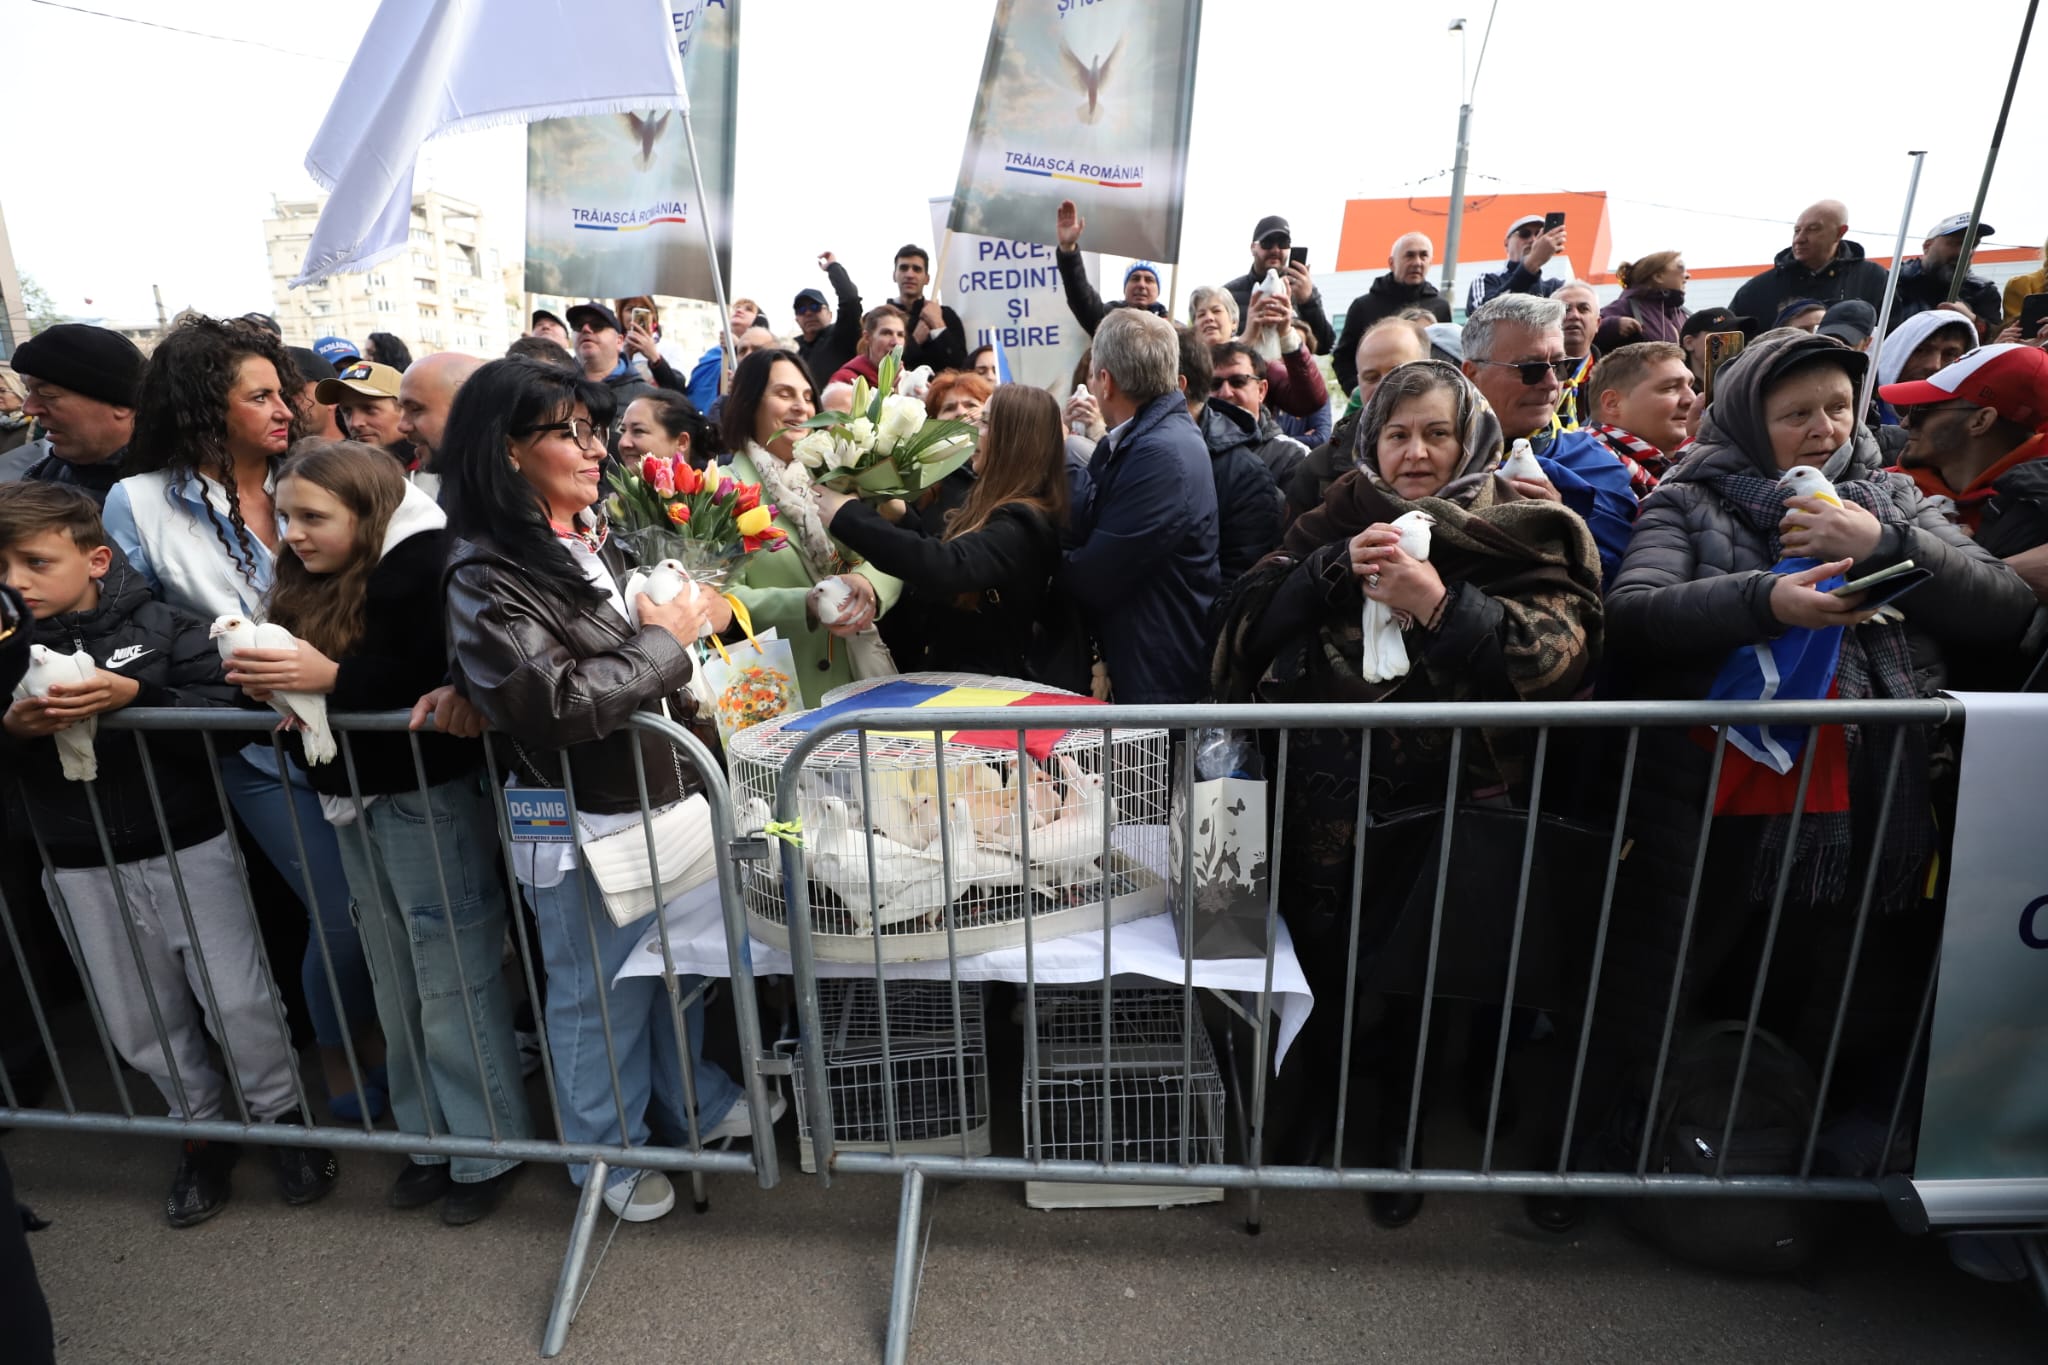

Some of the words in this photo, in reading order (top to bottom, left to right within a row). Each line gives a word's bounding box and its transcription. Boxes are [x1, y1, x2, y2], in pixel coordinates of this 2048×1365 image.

[1005, 151, 1075, 173] TRĂIASCĂ
[1079, 164, 1144, 179] ROMÂNIA!
[979, 240, 1051, 261] PACE,
[959, 265, 1059, 293] CREDINȚ
[1007, 298, 1029, 325] ȘI
[112, 644, 144, 661] NIKE
[510, 801, 566, 818] DGJMB
